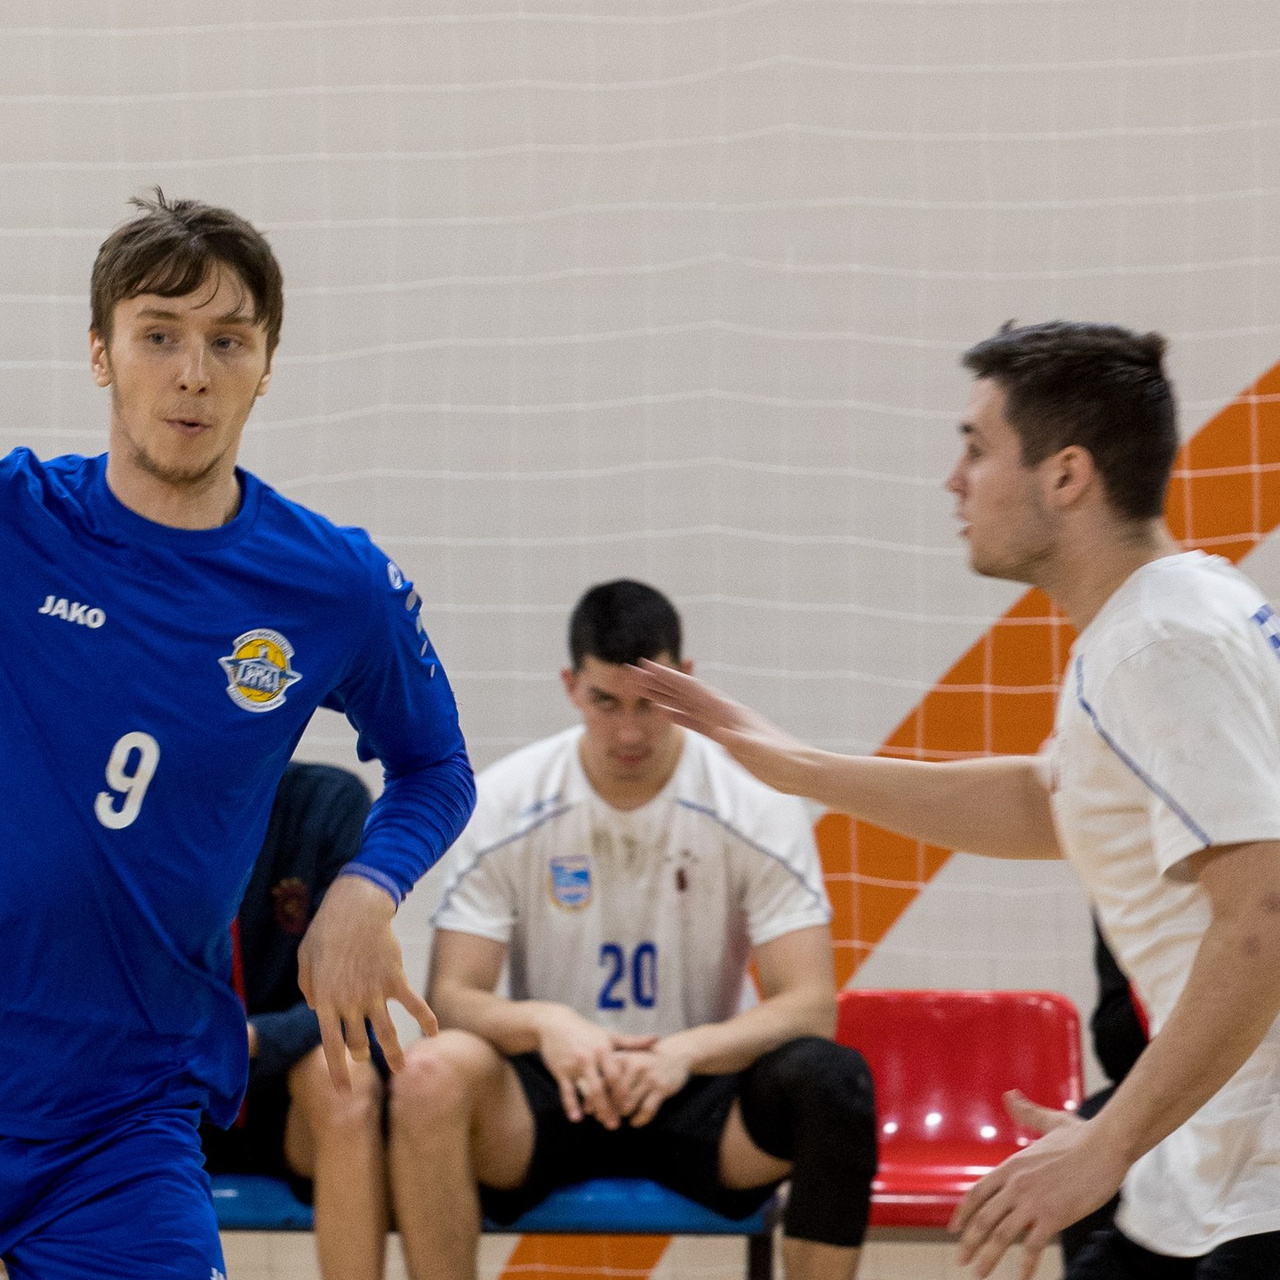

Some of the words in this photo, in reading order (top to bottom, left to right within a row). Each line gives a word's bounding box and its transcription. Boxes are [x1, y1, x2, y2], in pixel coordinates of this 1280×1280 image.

[37, 594, 107, 629] JAKO
[94, 731, 160, 830] 9
[596, 940, 658, 1011] 20
